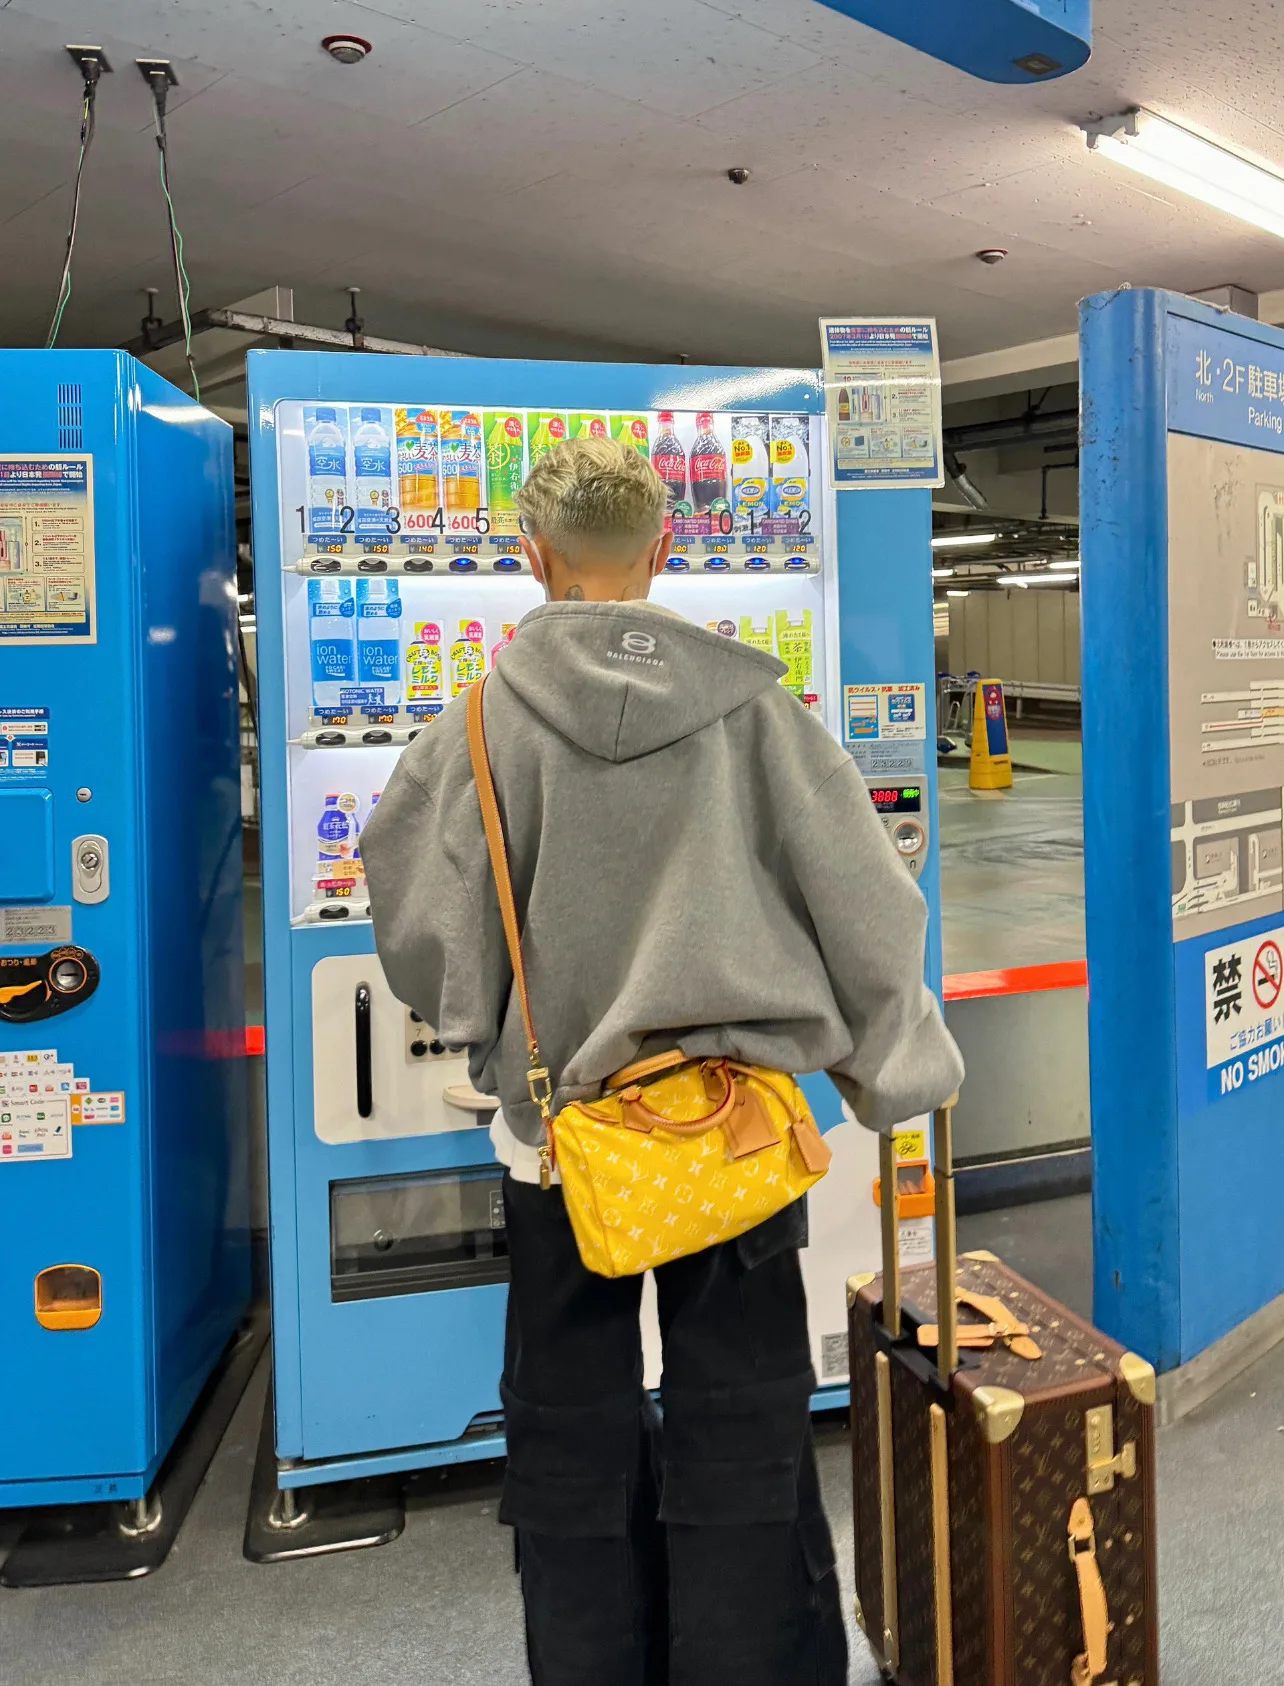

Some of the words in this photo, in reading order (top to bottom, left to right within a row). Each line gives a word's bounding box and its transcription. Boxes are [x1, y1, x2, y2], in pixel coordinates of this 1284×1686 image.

[1195, 388, 1214, 403] North
[1248, 406, 1283, 434] Parking
[734, 444, 750, 452] No.1
[776, 444, 792, 452] No.1
[296, 506, 305, 533] 1
[340, 506, 355, 534] 2
[386, 506, 400, 534] 3
[432, 507, 446, 534] 4
[476, 508, 490, 534] 5
[316, 643, 337, 655] ion
[363, 643, 383, 655] ion
[316, 655, 351, 665] water
[363, 656, 398, 665] water
[412, 666, 439, 674] レモン
[457, 663, 482, 672] レモン
[412, 675, 438, 684] ミルク
[457, 672, 482, 681] ミルク
[336, 888, 350, 896] 150
[1212, 953, 1242, 1025] 禁
[416, 1028, 422, 1037] 7
[1220, 1060, 1244, 1096] NO
